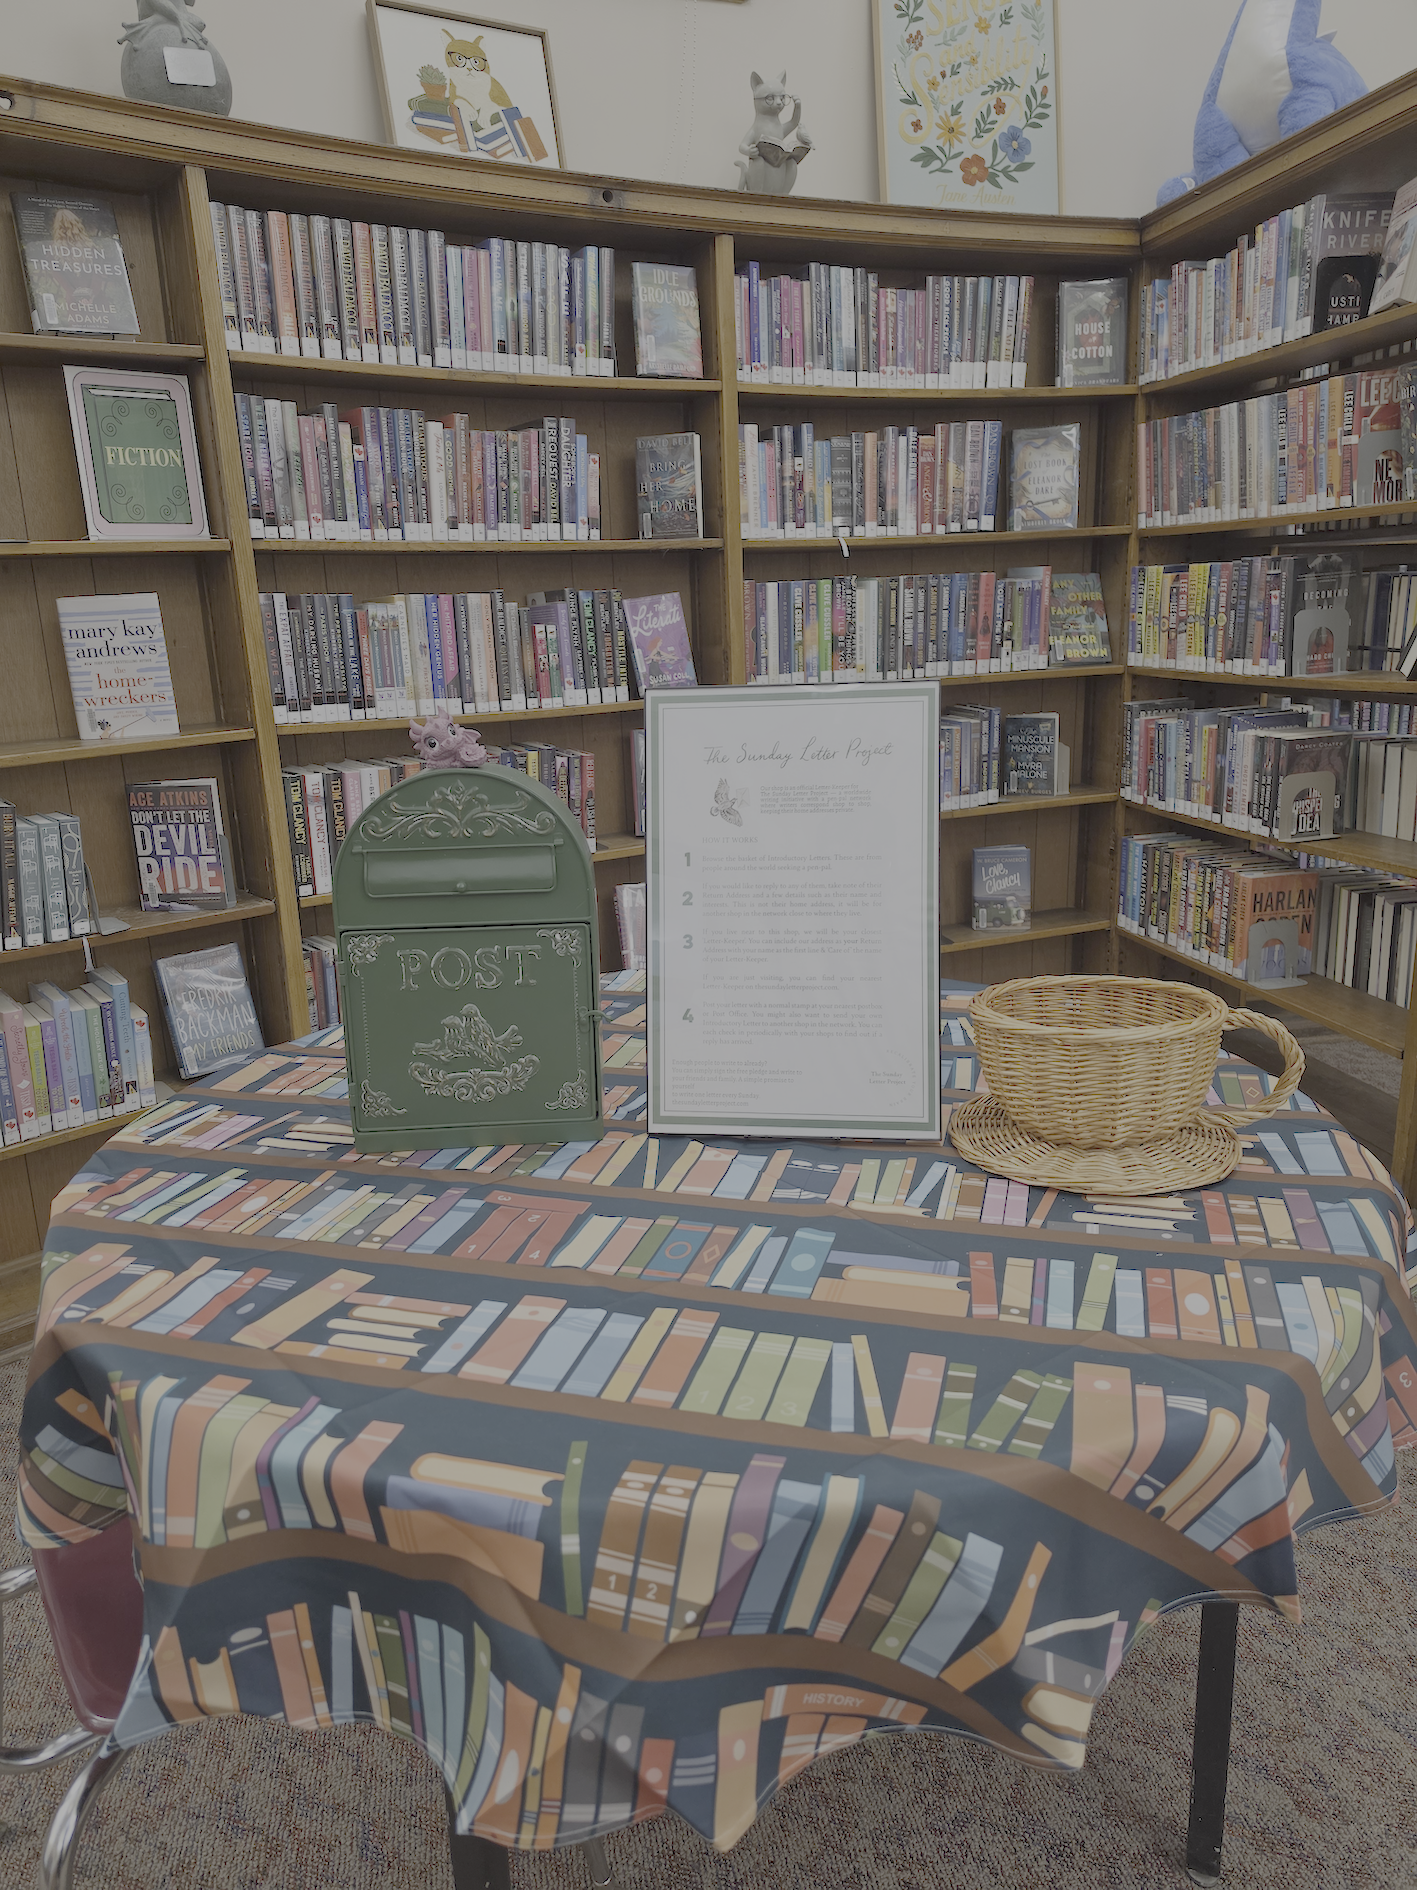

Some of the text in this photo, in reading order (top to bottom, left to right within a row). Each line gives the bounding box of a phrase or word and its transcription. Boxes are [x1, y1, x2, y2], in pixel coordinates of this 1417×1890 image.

[939, 36, 975, 68] and
[899, 24, 1034, 149] Sensibility
[932, 184, 1017, 206] Jane Austen
[1323, 209, 1392, 229] KNIFE
[1327, 233, 1384, 249] RIVER
[42, 244, 105, 259] HIDDEN
[31, 259, 122, 276] TREASURES
[652, 268, 679, 286] IDLE
[376, 241, 393, 332] DAVID BALDACCI
[639, 286, 697, 307] GROUNDS
[55, 301, 117, 314] MICHELLE
[67, 313, 110, 325] ADAMS
[1075, 321, 1111, 336] HOUSE
[1072, 345, 1113, 360] COTTON
[1361, 377, 1393, 407] LEE
[241, 413, 251, 441] SPARE
[255, 404, 272, 491] WE WERE NEVER HERE
[639, 435, 693, 449] DAVID BELL
[104, 446, 183, 468] FICTION
[244, 444, 254, 469] ROOM
[548, 429, 558, 481] REQUEST
[561, 427, 571, 489] DAUGHTER
[988, 424, 998, 486] DAN BROWN
[649, 460, 687, 473] BRING
[1024, 458, 1067, 470] LOST BOOK
[640, 481, 664, 492] HER
[650, 498, 697, 513] HOME
[1053, 580, 1075, 588] ANY
[1068, 591, 1103, 602] OTHER
[1304, 588, 1349, 600] BECOMING
[653, 603, 667, 612] THE
[824, 583, 832, 641] CLIVE CUSSLER
[1050, 605, 1088, 615] FAMILY
[568, 592, 581, 647] VINCE FLYNN
[632, 605, 682, 637] Literati
[904, 588, 914, 646] SANDRA BROWN
[68, 619, 157, 641] mary kay
[444, 612, 453, 646] MITFORD
[583, 596, 597, 656] TOM CLANCY
[432, 620, 440, 650] HIDDEN
[1048, 634, 1097, 646] ELEANOR
[76, 640, 158, 659] andrews
[264, 612, 280, 676] DEAR WIFE
[447, 647, 456, 672] AFFAIR
[1066, 647, 1108, 659] BROWN
[435, 651, 443, 680] GENIUS
[97, 673, 153, 689] home-
[649, 671, 672, 685] SUSAN
[84, 689, 167, 707] wreckers
[1007, 735, 1055, 744] MINUSCULE
[703, 736, 894, 768] The Sunday Letter Project
[1011, 744, 1051, 753] MANSION
[1018, 761, 1043, 770] MYRA
[129, 791, 208, 807] ACE ATKINS
[131, 810, 210, 824] DON'T LET THE
[290, 780, 307, 845] TOM CLANCY
[3, 813, 15, 870] BURN IT ALL
[133, 824, 216, 856] DEVIL
[731, 836, 759, 844] WORKS
[684, 852, 691, 867] 1
[866, 853, 882, 861] from
[138, 855, 222, 895] RIDE
[777, 864, 801, 872] seeking
[806, 864, 832, 872] pen-pal.
[981, 863, 1009, 881] Love,
[985, 872, 1021, 894] Clancy
[1139, 859, 1148, 914] HAMILTON
[682, 891, 694, 906] 2
[1253, 887, 1317, 913] HARLAN
[1219, 885, 1230, 947] HARLAN COBEN
[682, 934, 694, 949] 3
[397, 945, 542, 990] POST
[119, 991, 127, 1021] Cutting
[176, 1001, 256, 1044] BACKMAN
[682, 1008, 694, 1023] 4
[192, 1029, 256, 1061] MY FRIENDS
[527, 1214, 542, 1223] 2
[467, 1244, 477, 1254] 1
[529, 1250, 541, 1260] 4
[1399, 1372, 1413, 1389] 3
[698, 1389, 711, 1404] 1
[735, 1396, 756, 1412] 2
[780, 1401, 799, 1418] 3
[607, 1574, 617, 1591] 1
[646, 1584, 658, 1600] 2
[802, 1692, 865, 1708] HISTORY
